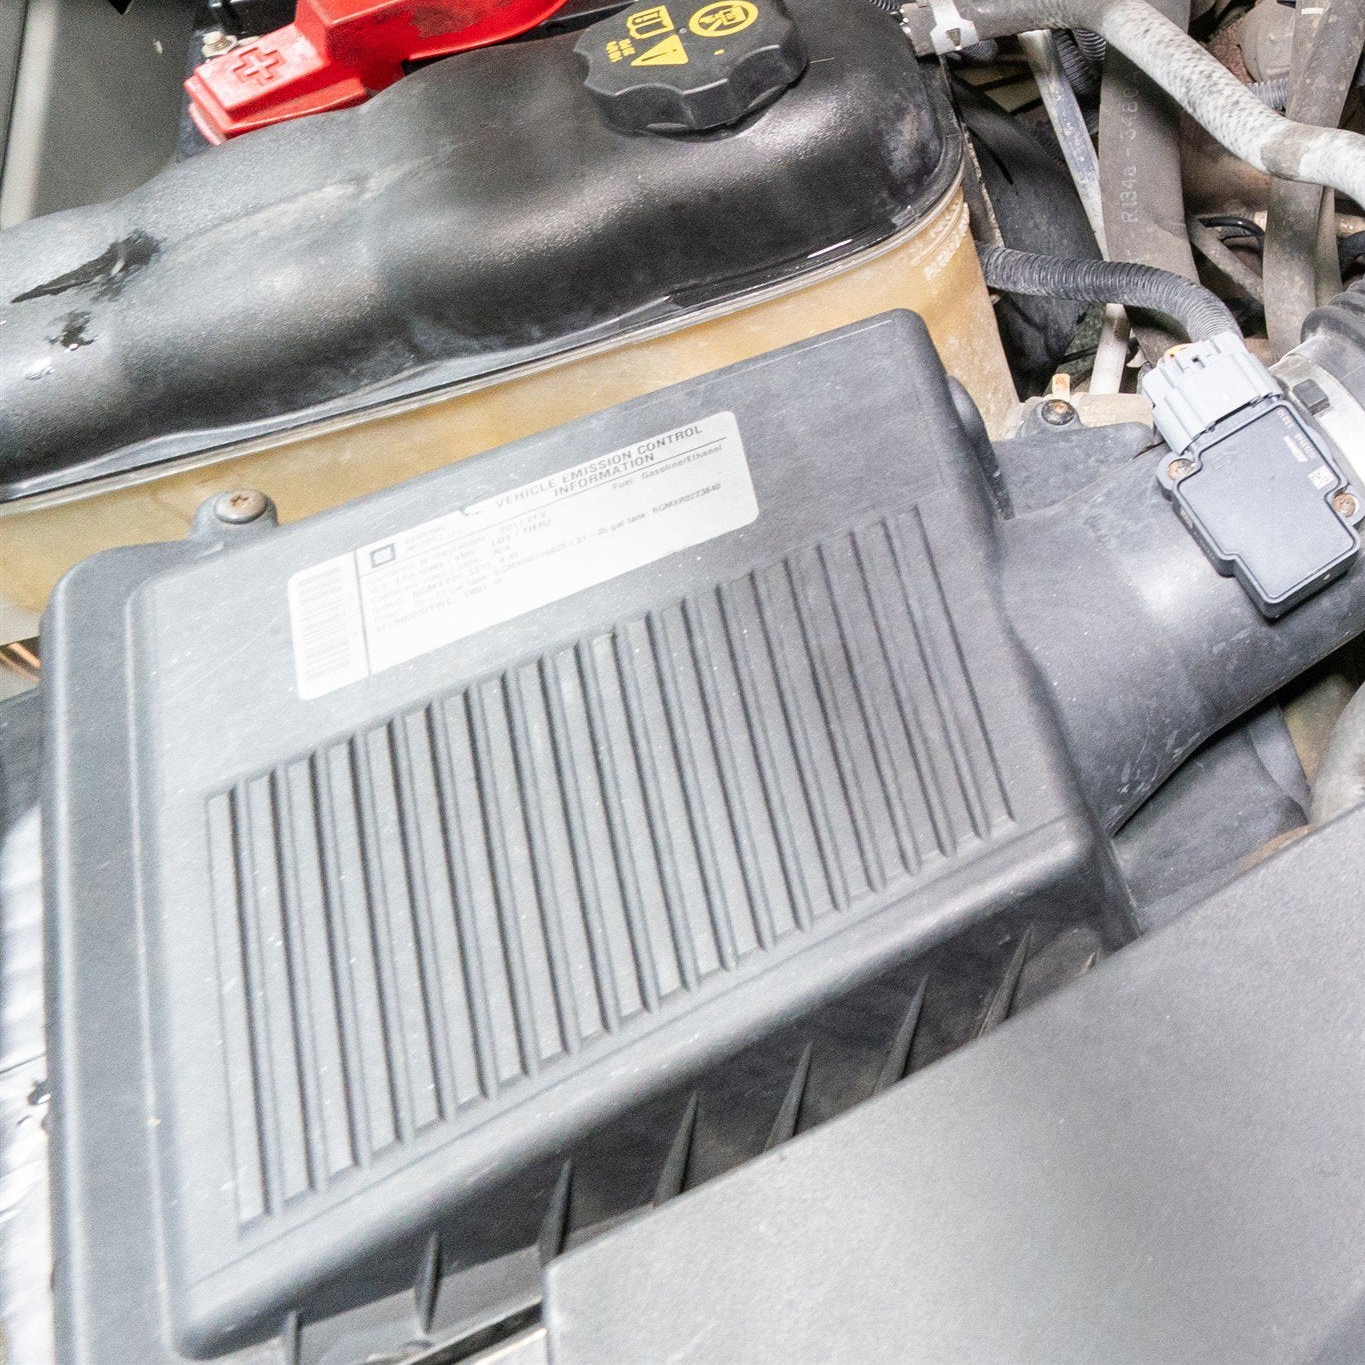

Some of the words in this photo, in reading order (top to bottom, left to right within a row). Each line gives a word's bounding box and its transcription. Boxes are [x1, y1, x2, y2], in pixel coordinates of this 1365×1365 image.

[495, 480, 555, 508] VEHICLE
[561, 451, 631, 484] EMISSION
[636, 425, 702, 455] CONTROL
[553, 453, 655, 497] INFORMATION
